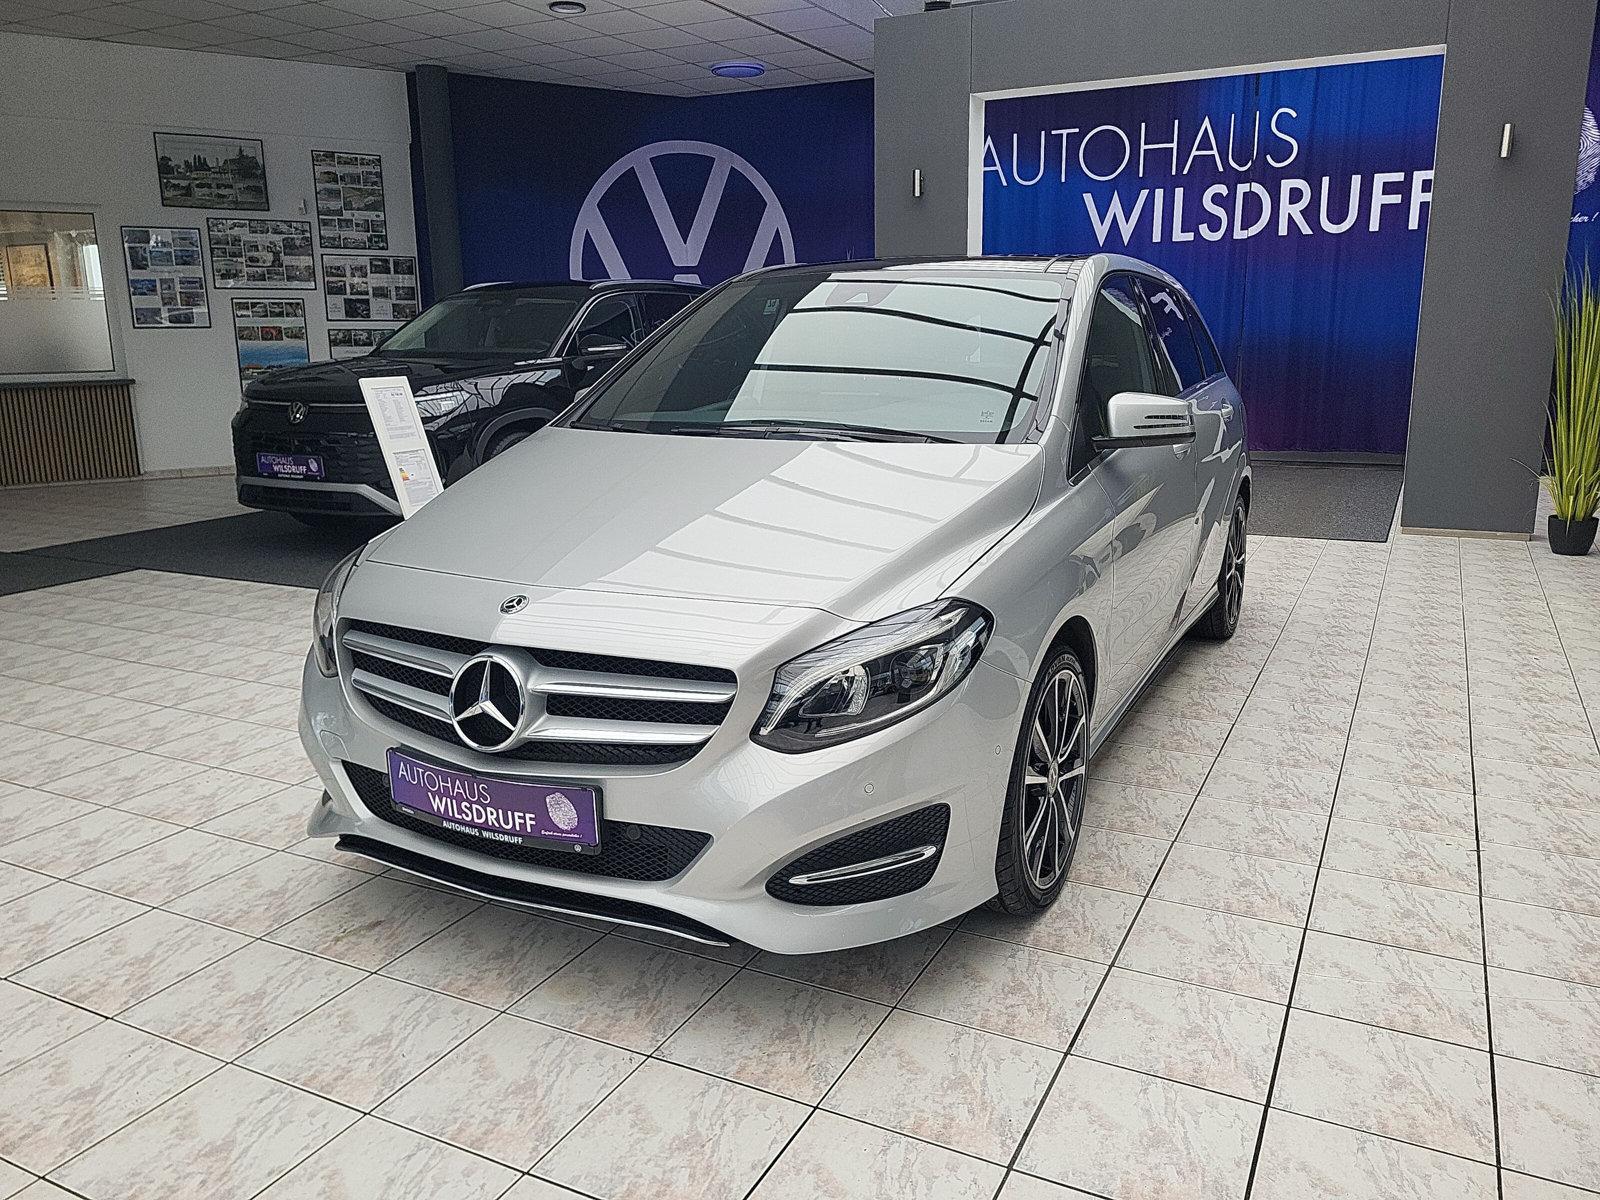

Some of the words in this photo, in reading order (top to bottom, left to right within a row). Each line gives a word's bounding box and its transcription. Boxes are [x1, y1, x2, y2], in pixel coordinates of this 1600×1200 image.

[983, 107, 1298, 187] AUTOHAUS
[1083, 170, 1434, 248] WILSDRUFF
[398, 762, 491, 803] AUTOHAUS
[428, 792, 536, 833] WILSDRUFF
[442, 820, 480, 837] AUTOHAUS
[481, 829, 523, 845] WILSDRUFF
